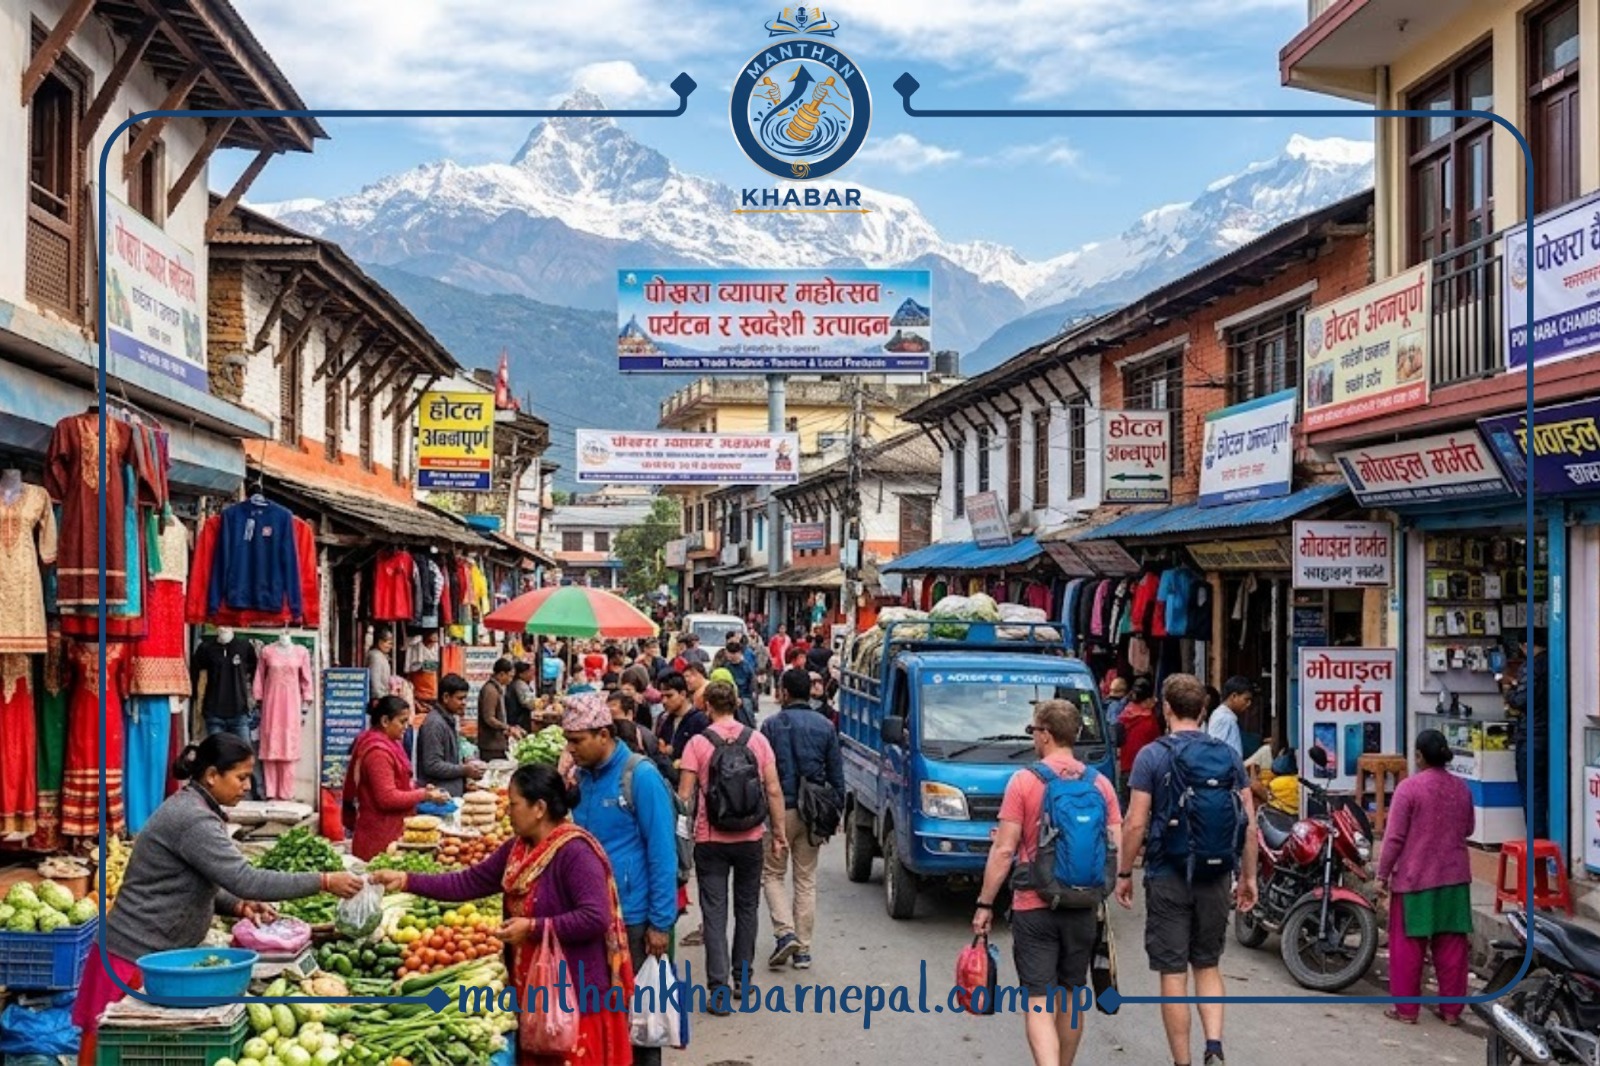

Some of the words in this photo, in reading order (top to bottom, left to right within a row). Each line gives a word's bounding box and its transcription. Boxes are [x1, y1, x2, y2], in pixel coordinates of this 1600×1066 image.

[1536, 234, 1585, 271] पोखरा
[644, 277, 711, 304] पोखरा
[718, 283, 789, 304] व्यापार
[795, 277, 881, 305] महोत्सव
[648, 310, 711, 337] पर्यटन
[718, 316, 732, 337] र
[740, 309, 805, 338] स्वदेशी
[813, 315, 890, 337] उत्पादन
[1324, 307, 1360, 350] होटल
[429, 396, 483, 420] होटल
[1108, 414, 1163, 438] होटल
[1306, 653, 1392, 683] मोवाइल
[1314, 684, 1383, 714] मर्मत
